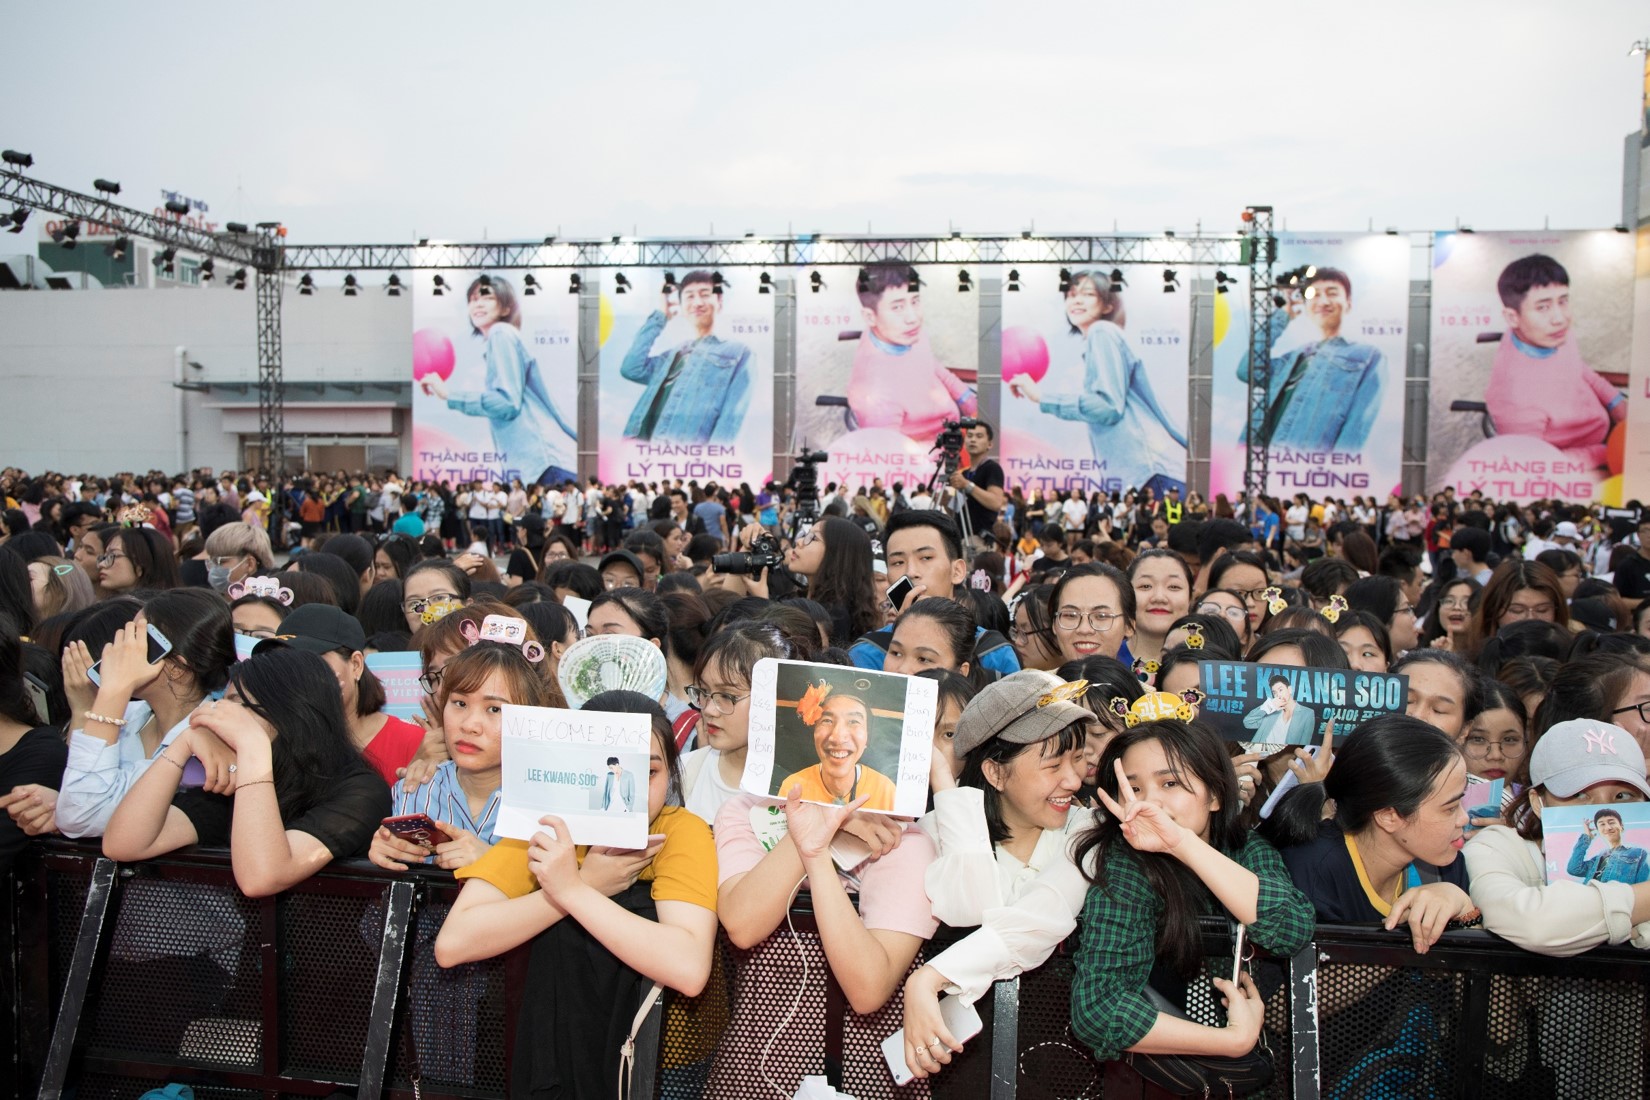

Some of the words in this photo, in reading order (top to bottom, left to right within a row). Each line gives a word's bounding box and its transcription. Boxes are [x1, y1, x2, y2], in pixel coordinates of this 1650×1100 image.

[805, 315, 850, 325] 10.5.19
[1441, 316, 1491, 326] 10.5.19
[732, 325, 769, 333] 10.5.19
[1362, 327, 1403, 335] 10.5.19
[535, 336, 569, 345] 10.5.19
[1141, 336, 1180, 345] 10.5.19
[708, 445, 735, 456] EM
[483, 452, 507, 463] EM
[1332, 453, 1362, 465] EM
[628, 459, 653, 477] LÝ
[1080, 460, 1107, 470] EM
[1552, 462, 1585, 474] EM
[420, 465, 441, 483] LÝ
[1006, 472, 1032, 491] LÝ
[1457, 475, 1488, 496] LÝ
[1204, 664, 1247, 698] LEE
[1354, 674, 1401, 711] SOO
[1583, 728, 1617, 755] NY
[528, 768, 541, 782] LEE
[543, 770, 576, 785] KWANG
[579, 774, 597, 787] SOO
